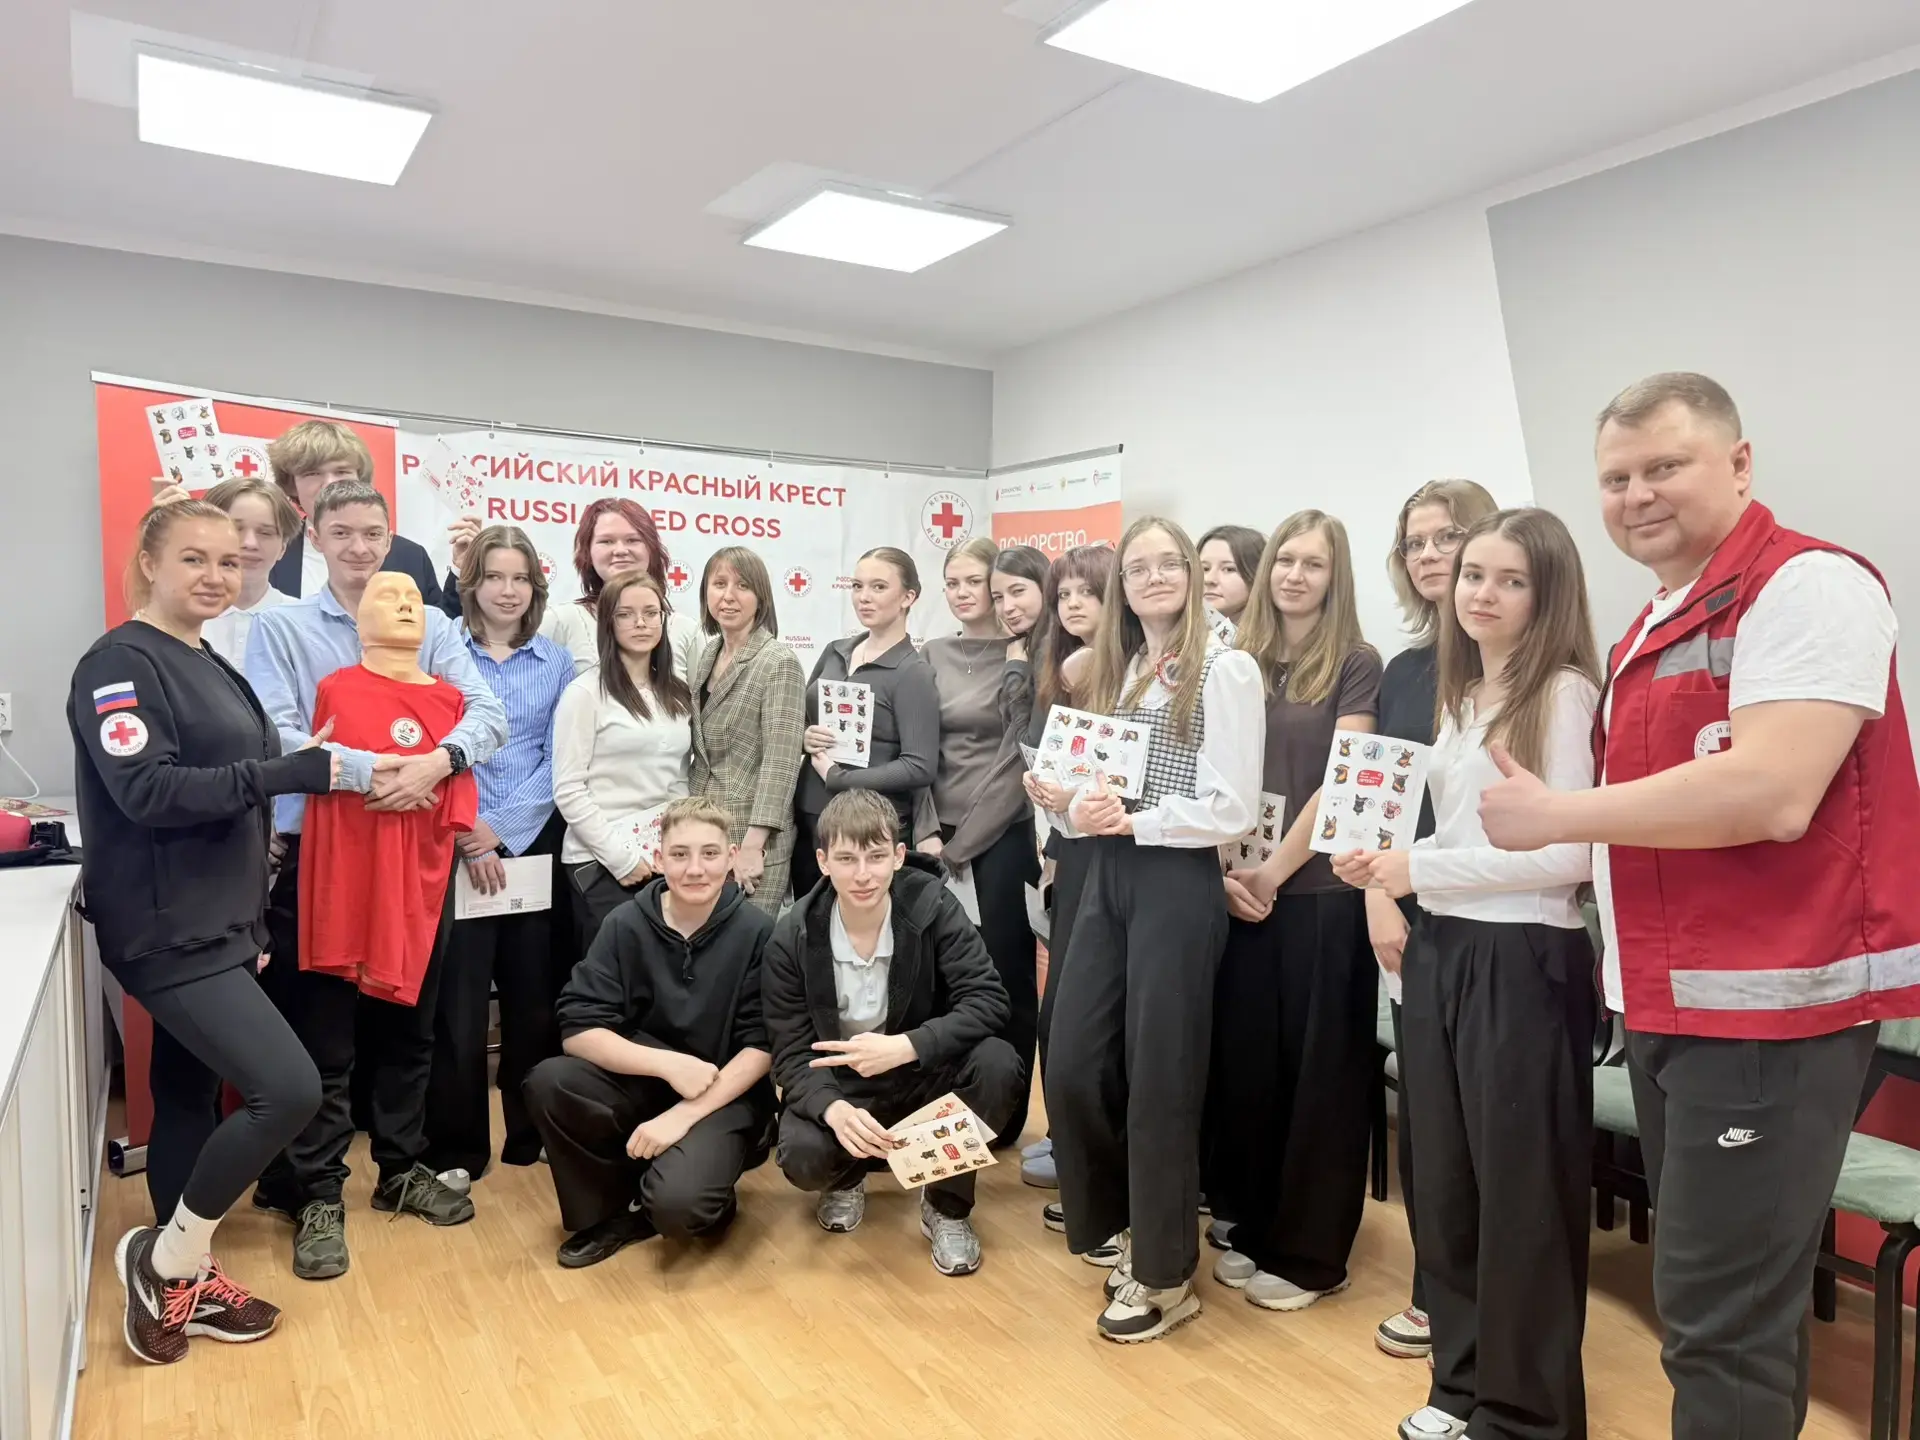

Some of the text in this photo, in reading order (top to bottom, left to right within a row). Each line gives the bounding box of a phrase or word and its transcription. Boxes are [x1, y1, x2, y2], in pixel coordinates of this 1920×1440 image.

[401, 452, 619, 488] РСИЙСКИЙ
[628, 468, 762, 500] КРАСНЫЙ
[769, 482, 847, 507] КРЕСТ
[928, 494, 965, 508] RUSSIAN
[488, 497, 782, 539] RUSSI ED CROSS
[1725, 1127, 1755, 1141] NIKE
